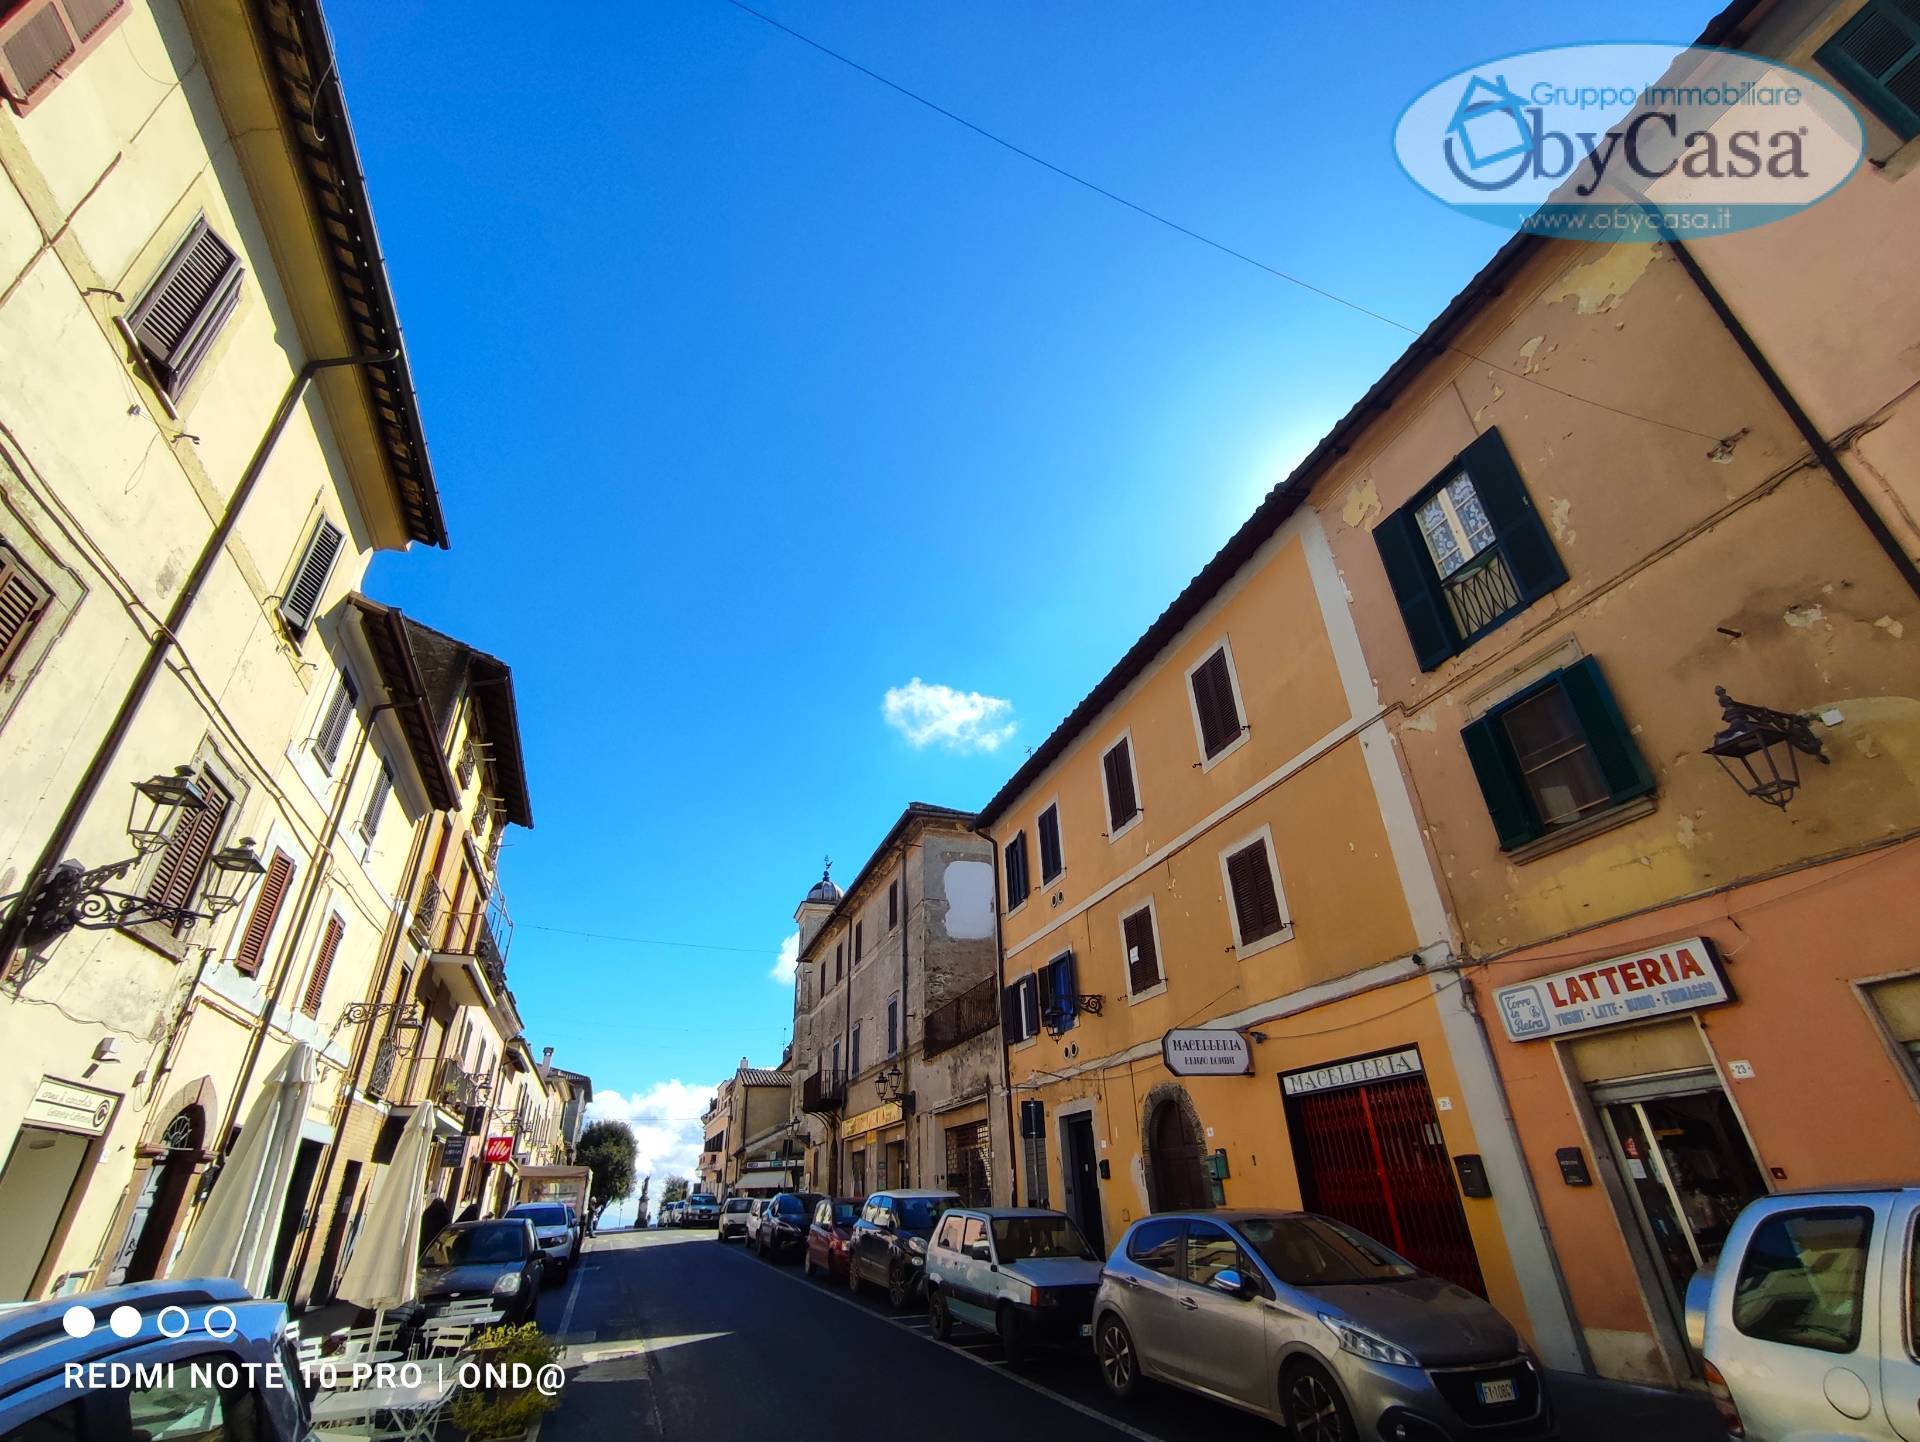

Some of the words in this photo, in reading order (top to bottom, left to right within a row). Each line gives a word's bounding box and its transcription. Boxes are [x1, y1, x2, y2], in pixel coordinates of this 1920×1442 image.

[1546, 948, 1705, 1008] LATTERIA
[1591, 1002, 1619, 1019] LATTE
[1172, 1039, 1242, 1051] MACELLERIA
[1289, 1055, 1412, 1093] MACELLERIA
[1735, 1064, 1747, 1075] 23
[487, 1140, 511, 1160] illy
